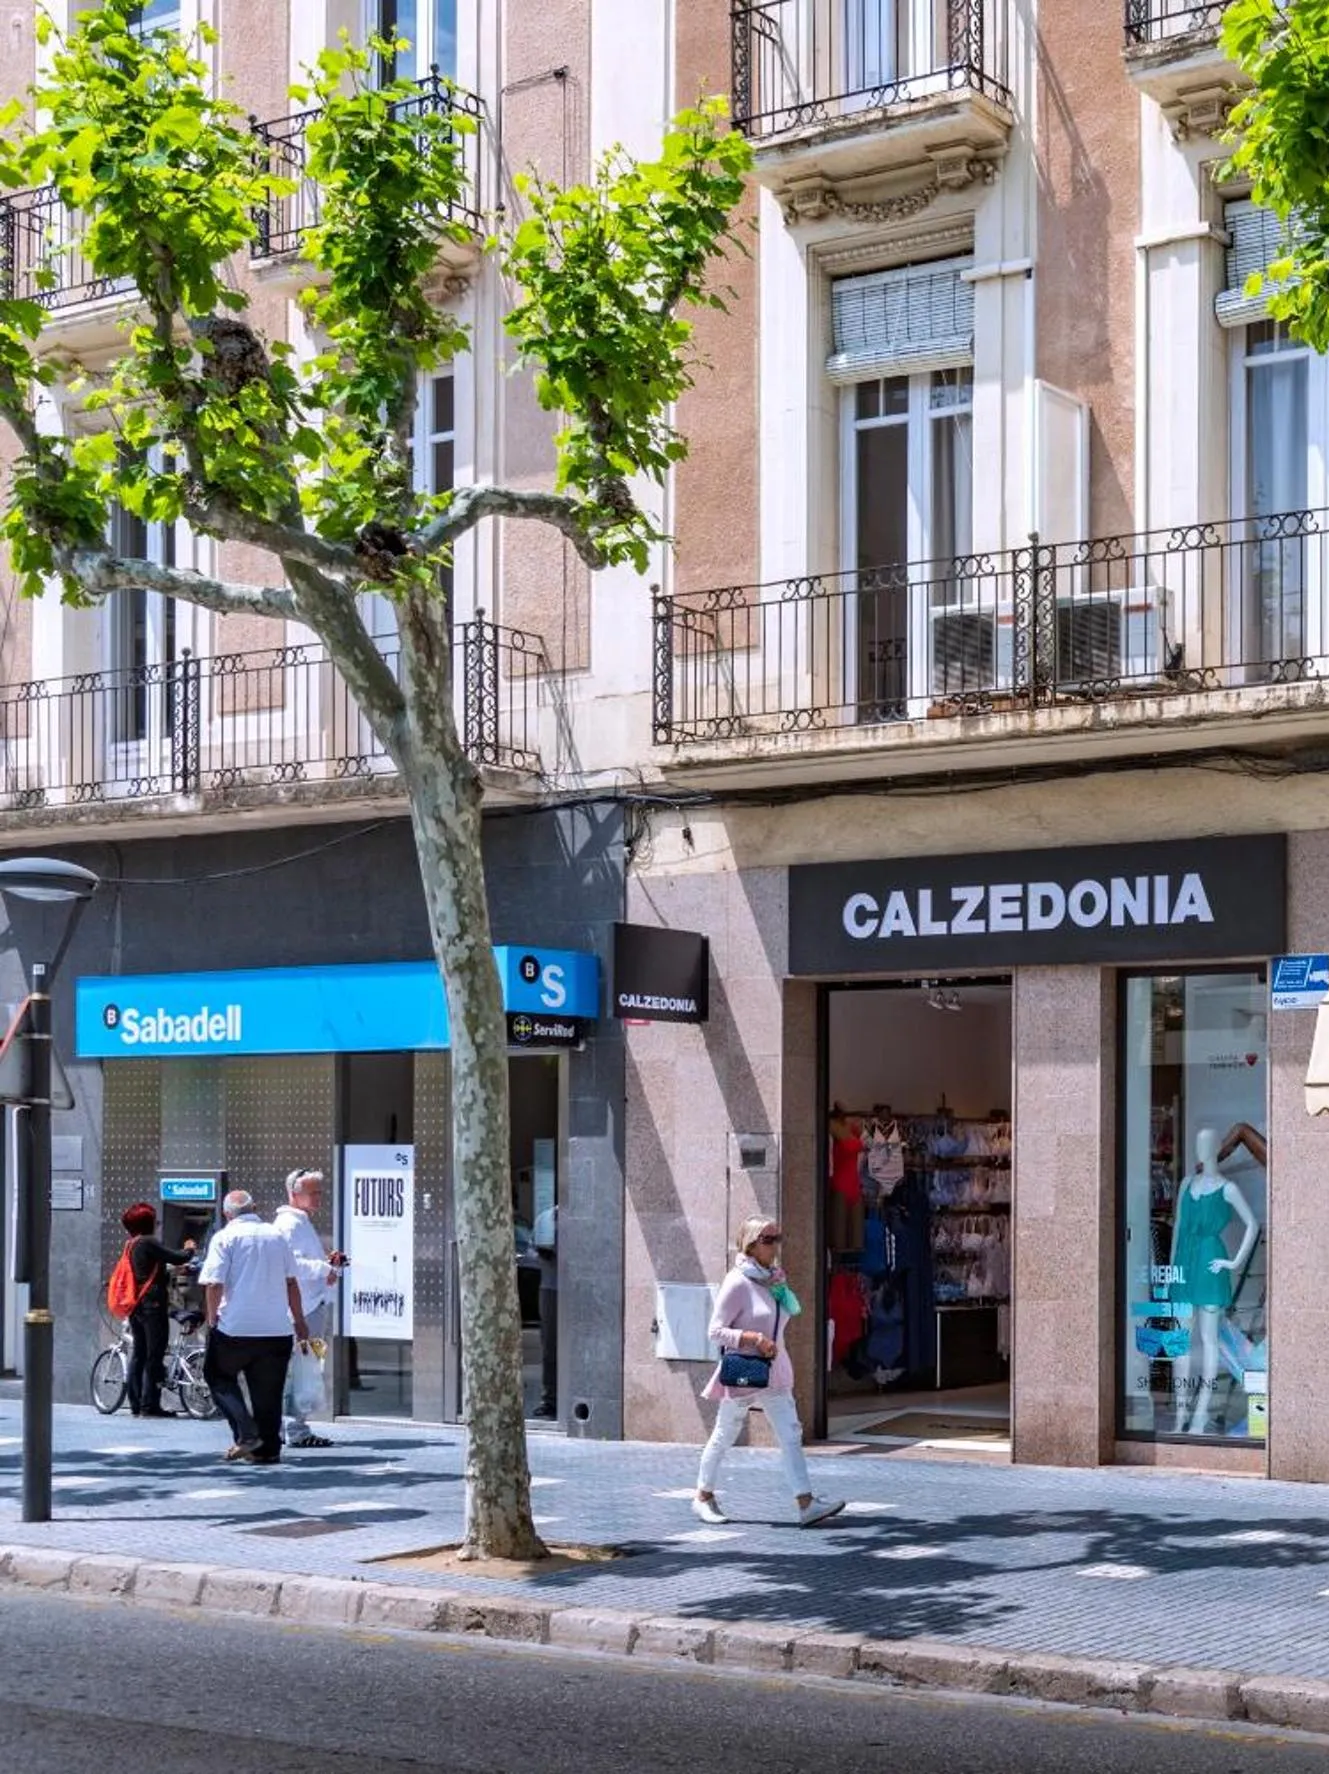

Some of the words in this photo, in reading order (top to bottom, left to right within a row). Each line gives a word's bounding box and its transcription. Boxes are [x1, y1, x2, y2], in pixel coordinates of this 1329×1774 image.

[842, 873, 1214, 939] CALZEDONIA
[540, 964, 566, 1008] S
[618, 993, 698, 1012] CALZEDONIA
[120, 1005, 242, 1045] Sabadell
[533, 1023, 576, 1037] ServiRed
[354, 1177, 404, 1218] FUTURS
